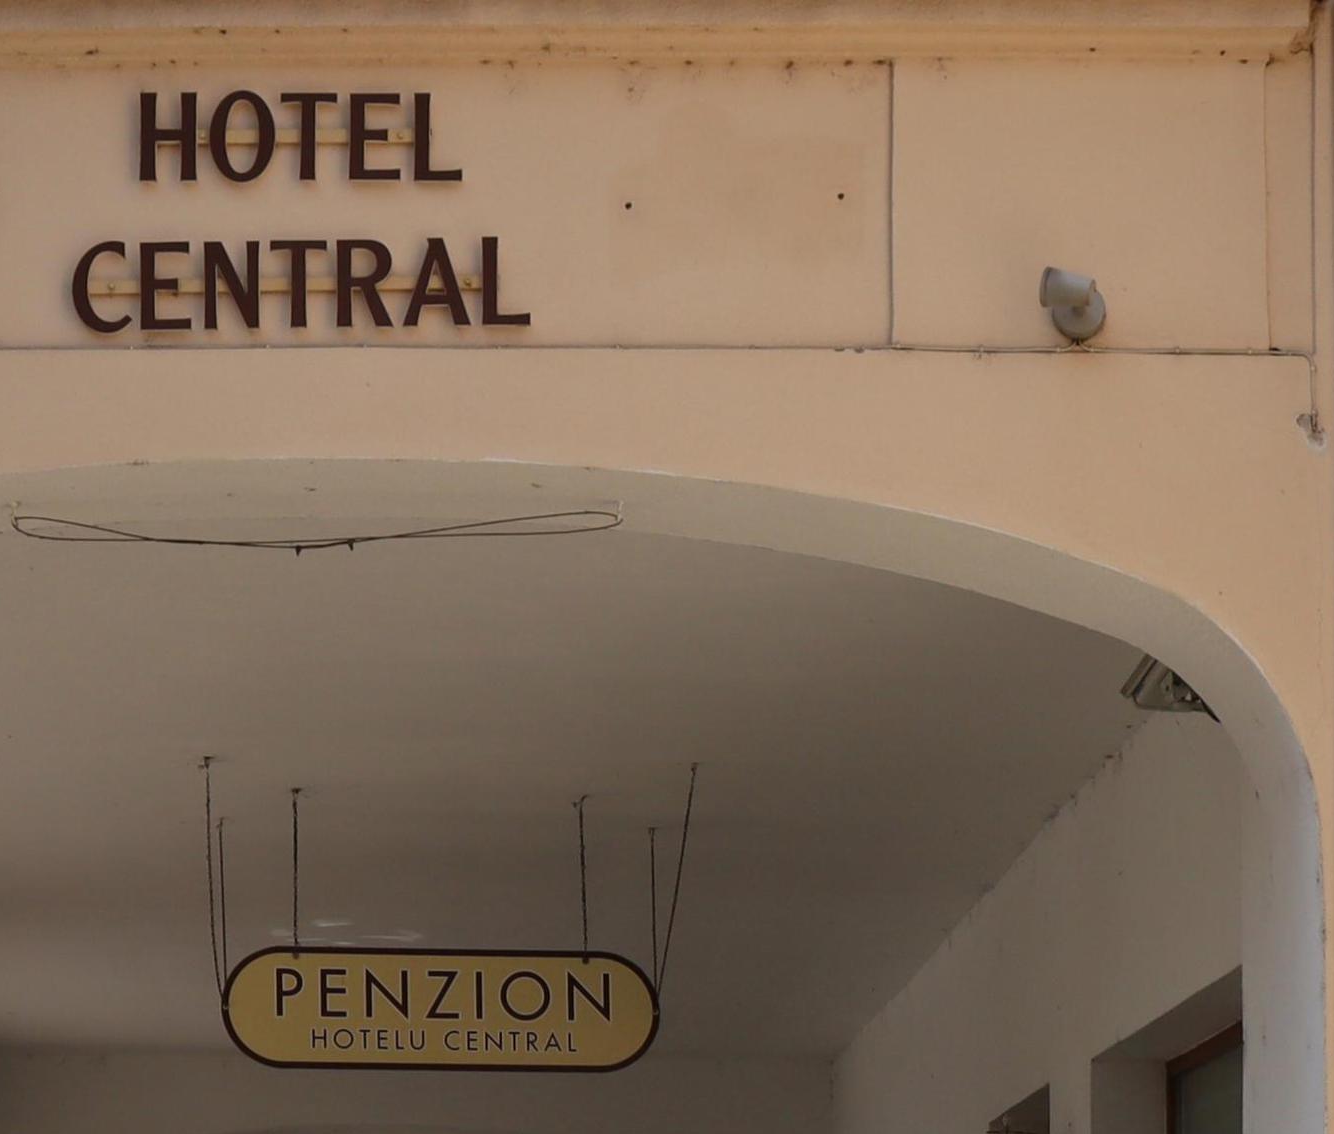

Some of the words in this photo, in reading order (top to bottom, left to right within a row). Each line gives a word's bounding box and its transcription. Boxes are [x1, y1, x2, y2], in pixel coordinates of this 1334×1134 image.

[138, 89, 463, 183] HOTEL
[71, 236, 532, 334] CENTRAL
[274, 967, 611, 1023] PENZION
[310, 1029, 427, 1051] HOTELU
[444, 1029, 578, 1053] CENTRAL
